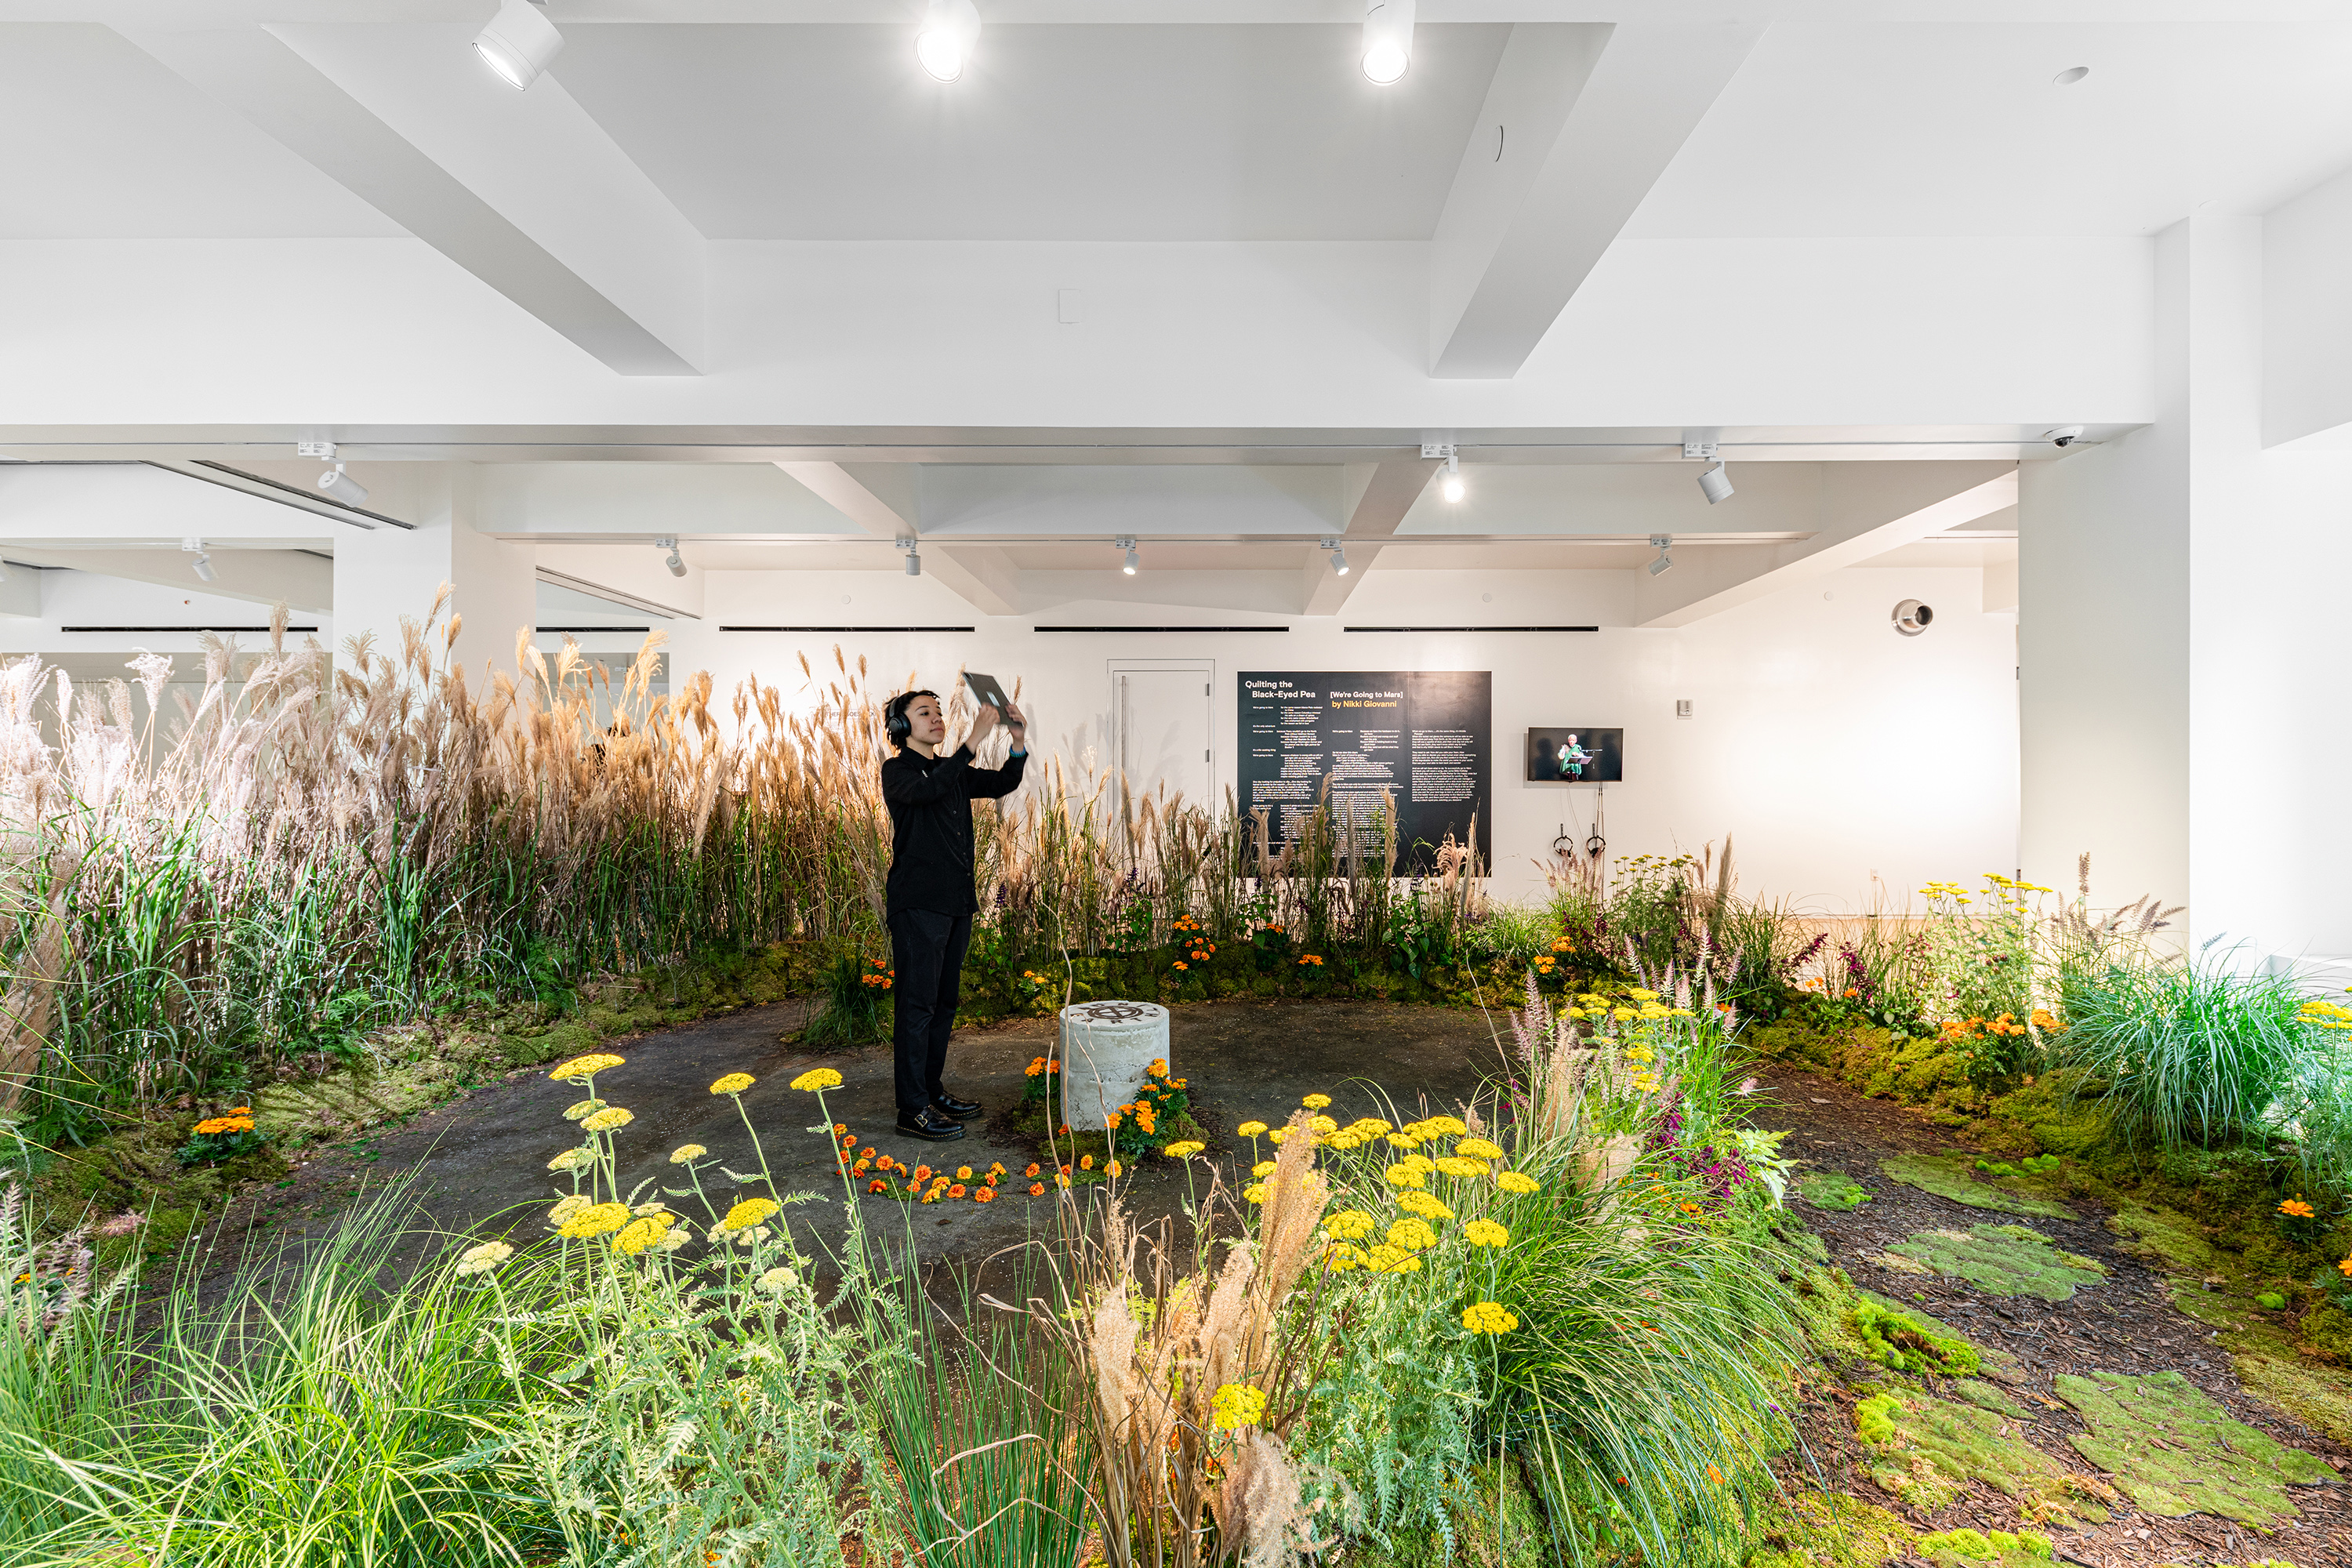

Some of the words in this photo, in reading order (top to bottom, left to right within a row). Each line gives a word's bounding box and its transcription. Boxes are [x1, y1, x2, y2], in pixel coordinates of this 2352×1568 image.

[1245, 681, 1277, 690] Quilting
[1252, 691, 1298, 699] Black-Eyed
[1332, 700, 1341, 709] by
